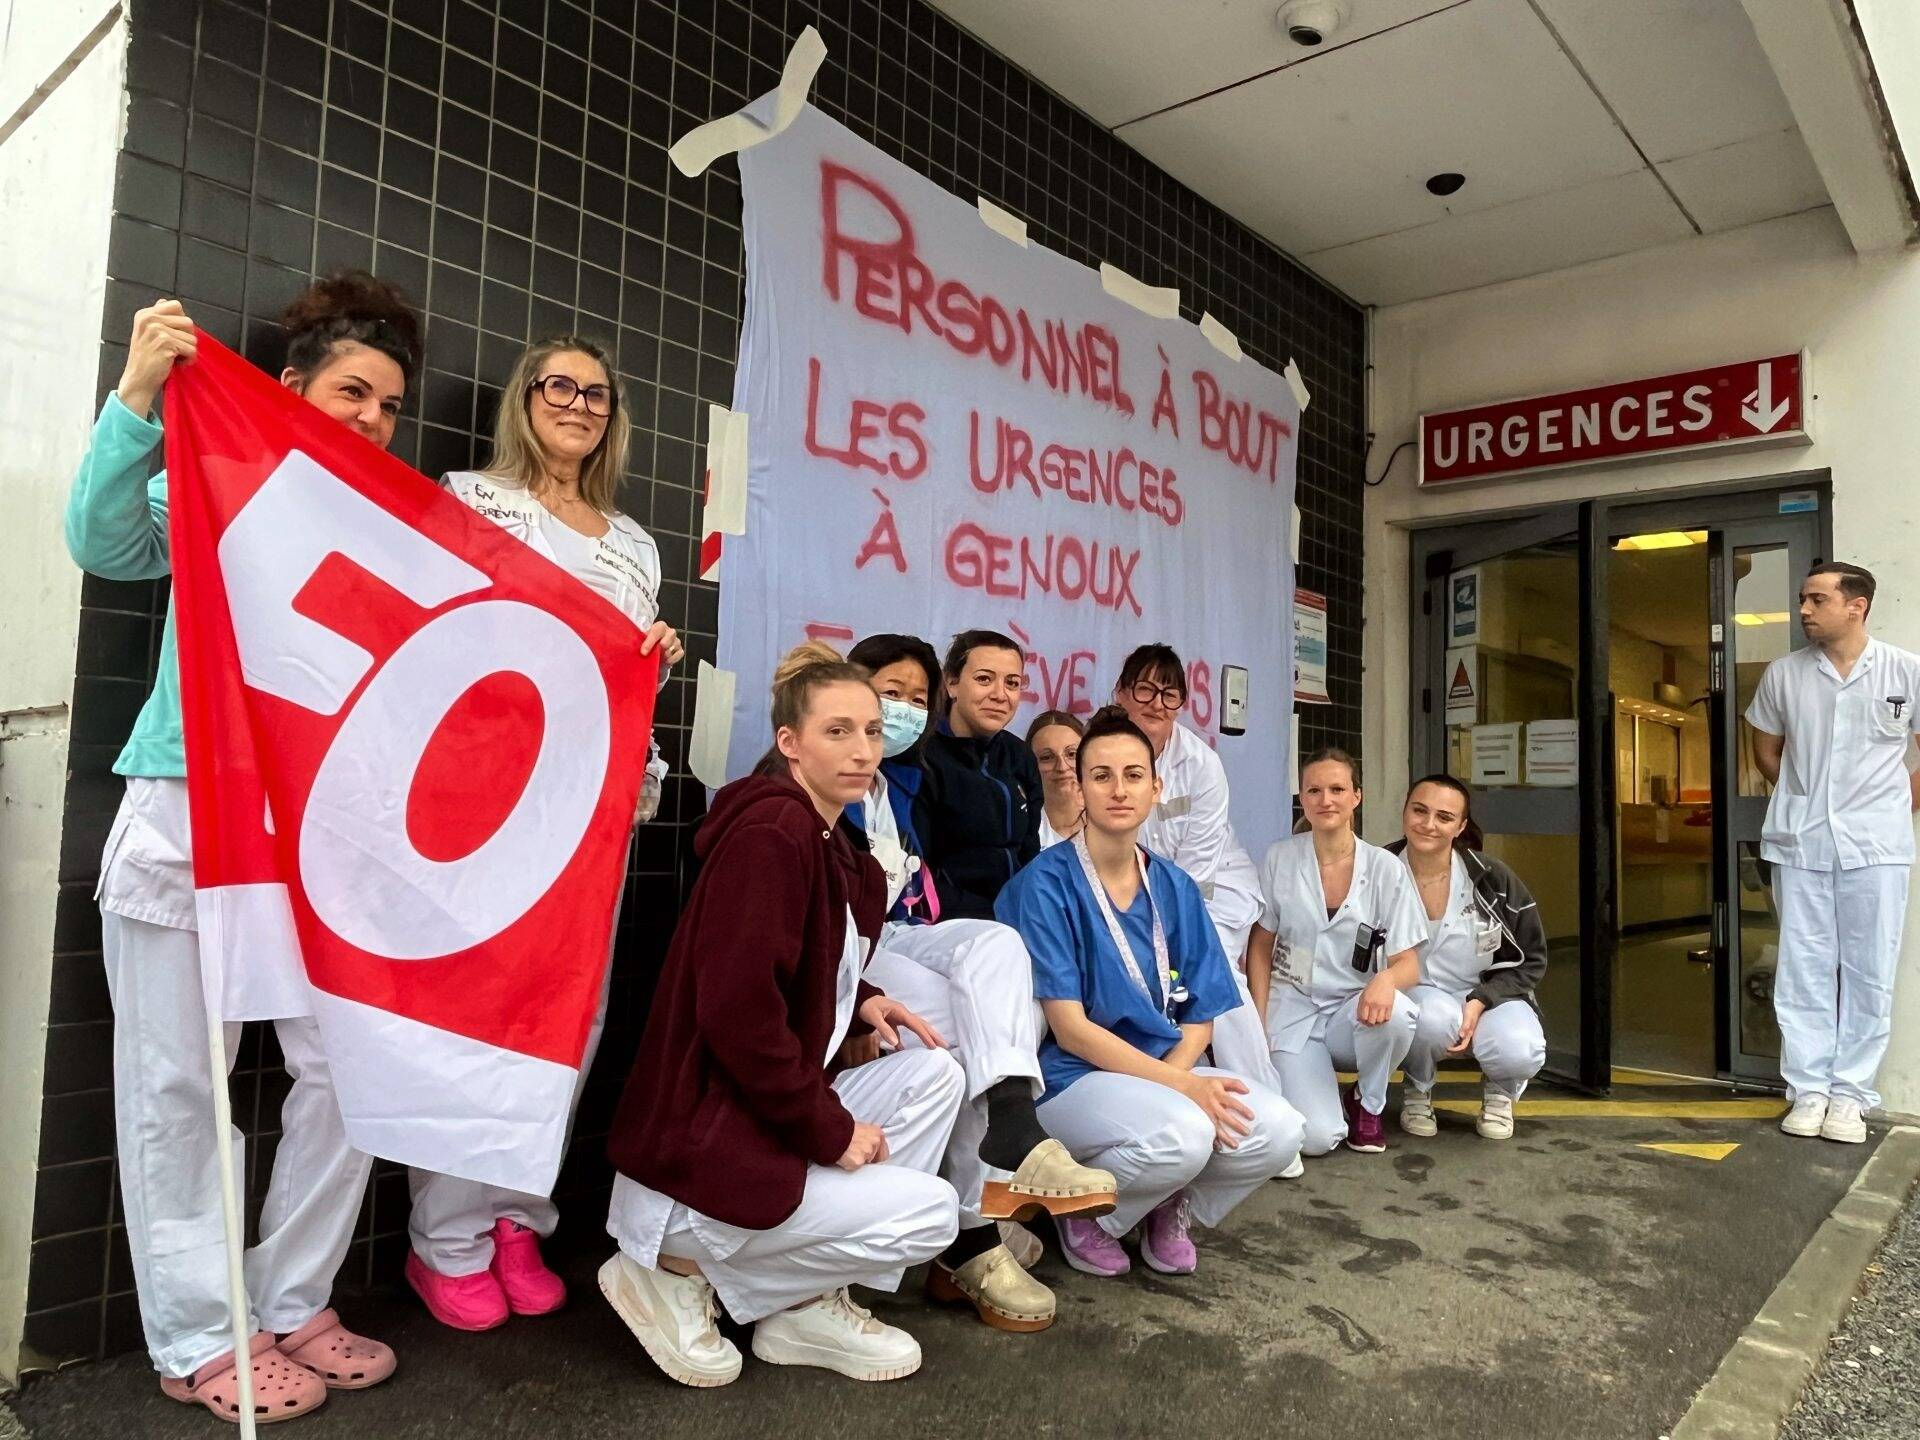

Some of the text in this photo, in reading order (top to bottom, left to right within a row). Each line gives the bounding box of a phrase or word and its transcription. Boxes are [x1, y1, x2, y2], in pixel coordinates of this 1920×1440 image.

[819, 158, 1292, 485] PERSONNEL À BOUT
[474, 483, 496, 501] EN
[805, 356, 1186, 527] LES URGENCES
[1433, 385, 1713, 469] URGENCES
[855, 488, 1143, 618] À GENOUX
[217, 448, 612, 961] FO
[1008, 619, 1097, 715] ÈVE
